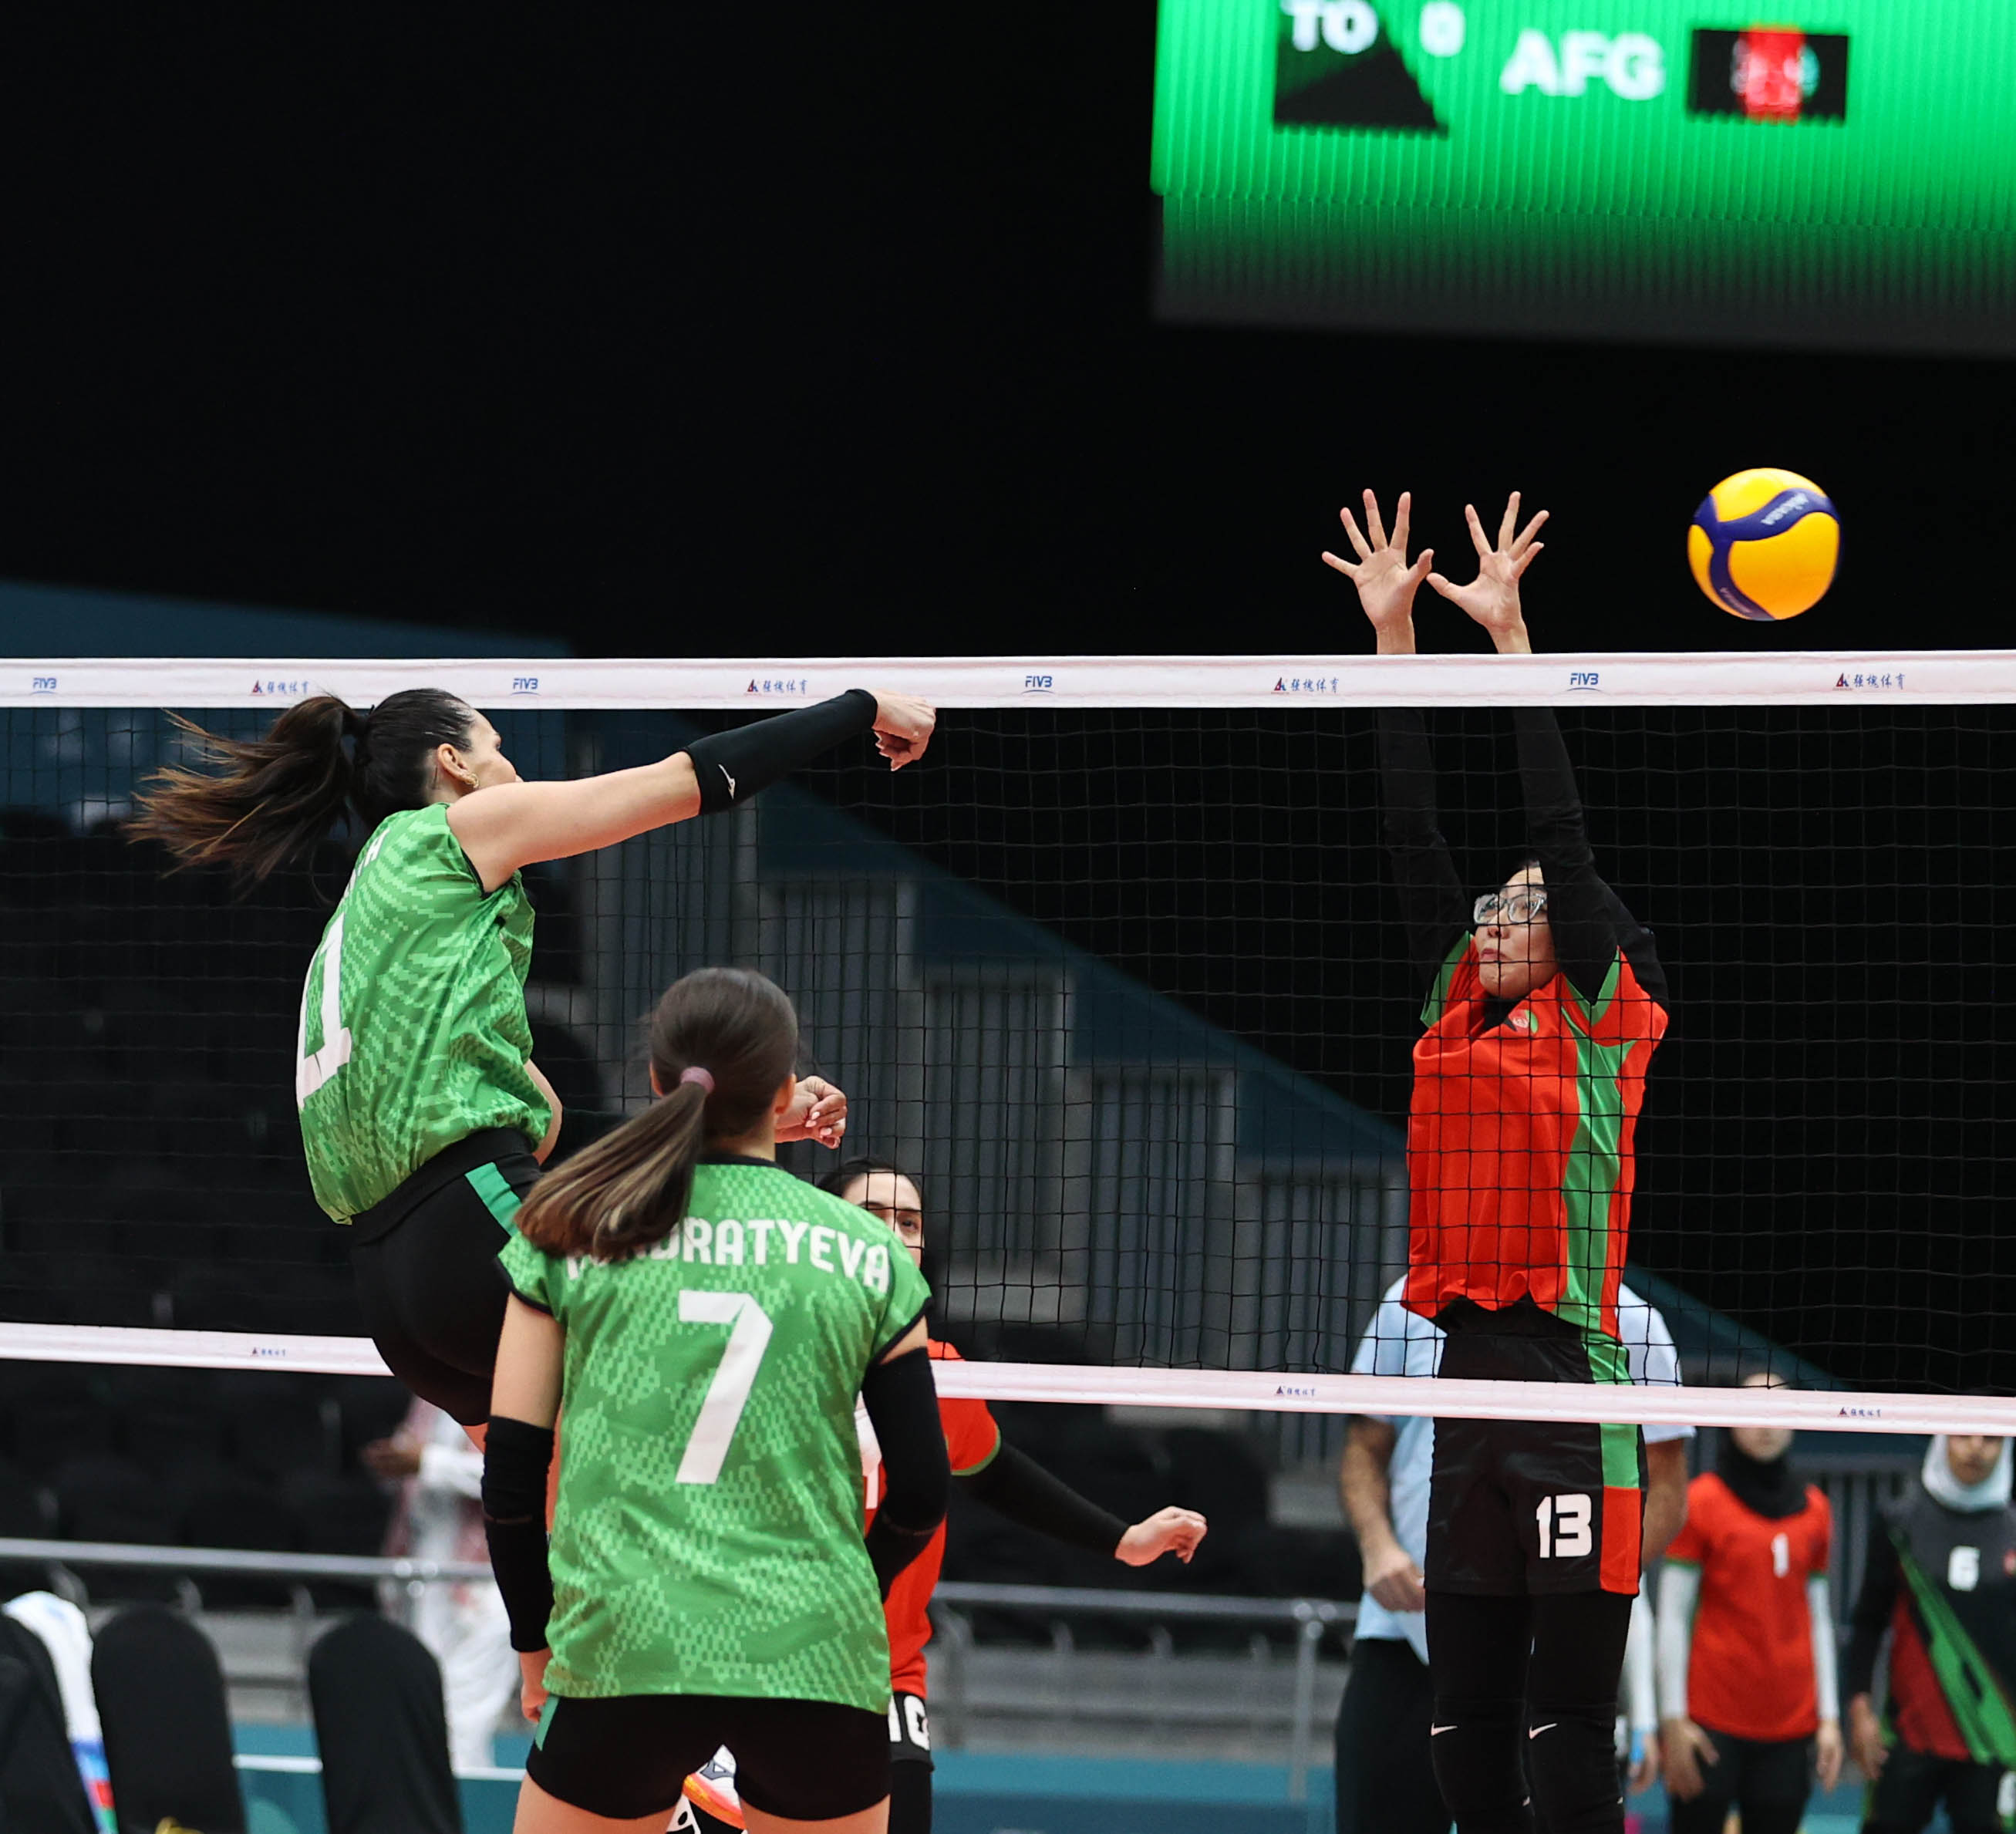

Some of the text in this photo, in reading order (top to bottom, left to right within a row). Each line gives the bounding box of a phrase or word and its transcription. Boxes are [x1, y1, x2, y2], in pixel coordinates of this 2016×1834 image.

[1280, 0, 1378, 54] TO
[1499, 29, 1664, 99] AFG
[33, 678, 56, 689] FIVB
[513, 678, 538, 689] FIVB
[1025, 676, 1053, 687] FIVB
[1570, 673, 1599, 685] FIVB
[567, 1216, 890, 1293] DRATYEVA
[675, 1290, 773, 1485] 7
[1536, 1494, 1593, 1558] 13
[1772, 1532, 1789, 1578] 1
[1947, 1546, 1980, 1591] 6
